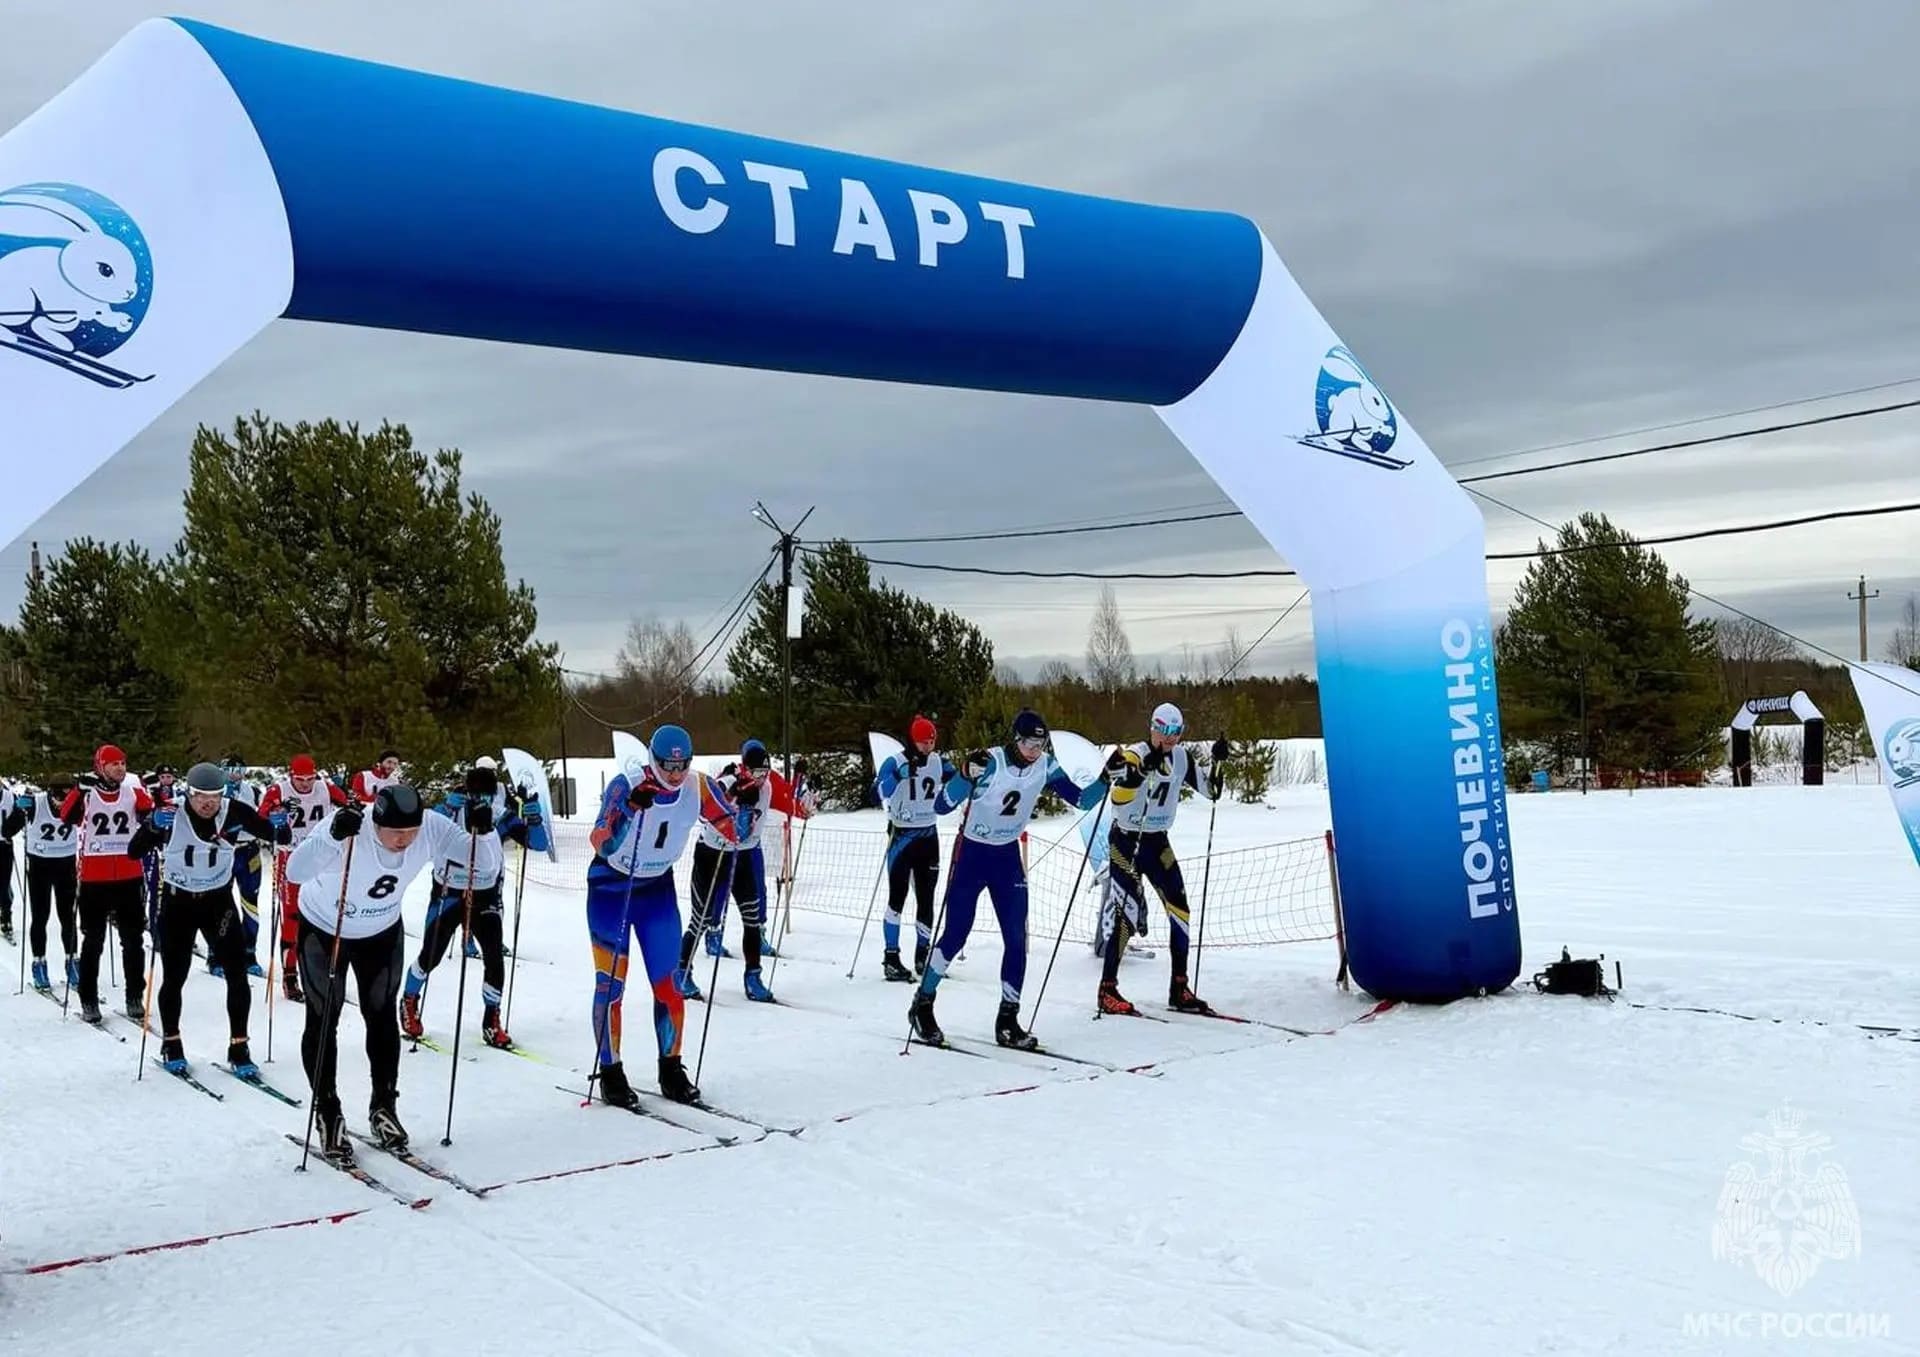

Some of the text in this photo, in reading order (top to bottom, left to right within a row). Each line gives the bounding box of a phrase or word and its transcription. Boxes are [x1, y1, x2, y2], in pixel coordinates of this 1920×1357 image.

[652, 147, 1036, 279] СТАРТ
[1441, 617, 1499, 919] ПОЧЕВИНО
[909, 777, 935, 800] 12
[289, 804, 324, 828] 24
[1000, 790, 1021, 816] 2
[1484, 712, 1512, 912] СПОРТИВНЫЙ
[40, 822, 73, 841] 29
[92, 810, 130, 836] 22
[654, 820, 669, 849] 1
[184, 845, 218, 868] 11
[367, 874, 399, 899] 8
